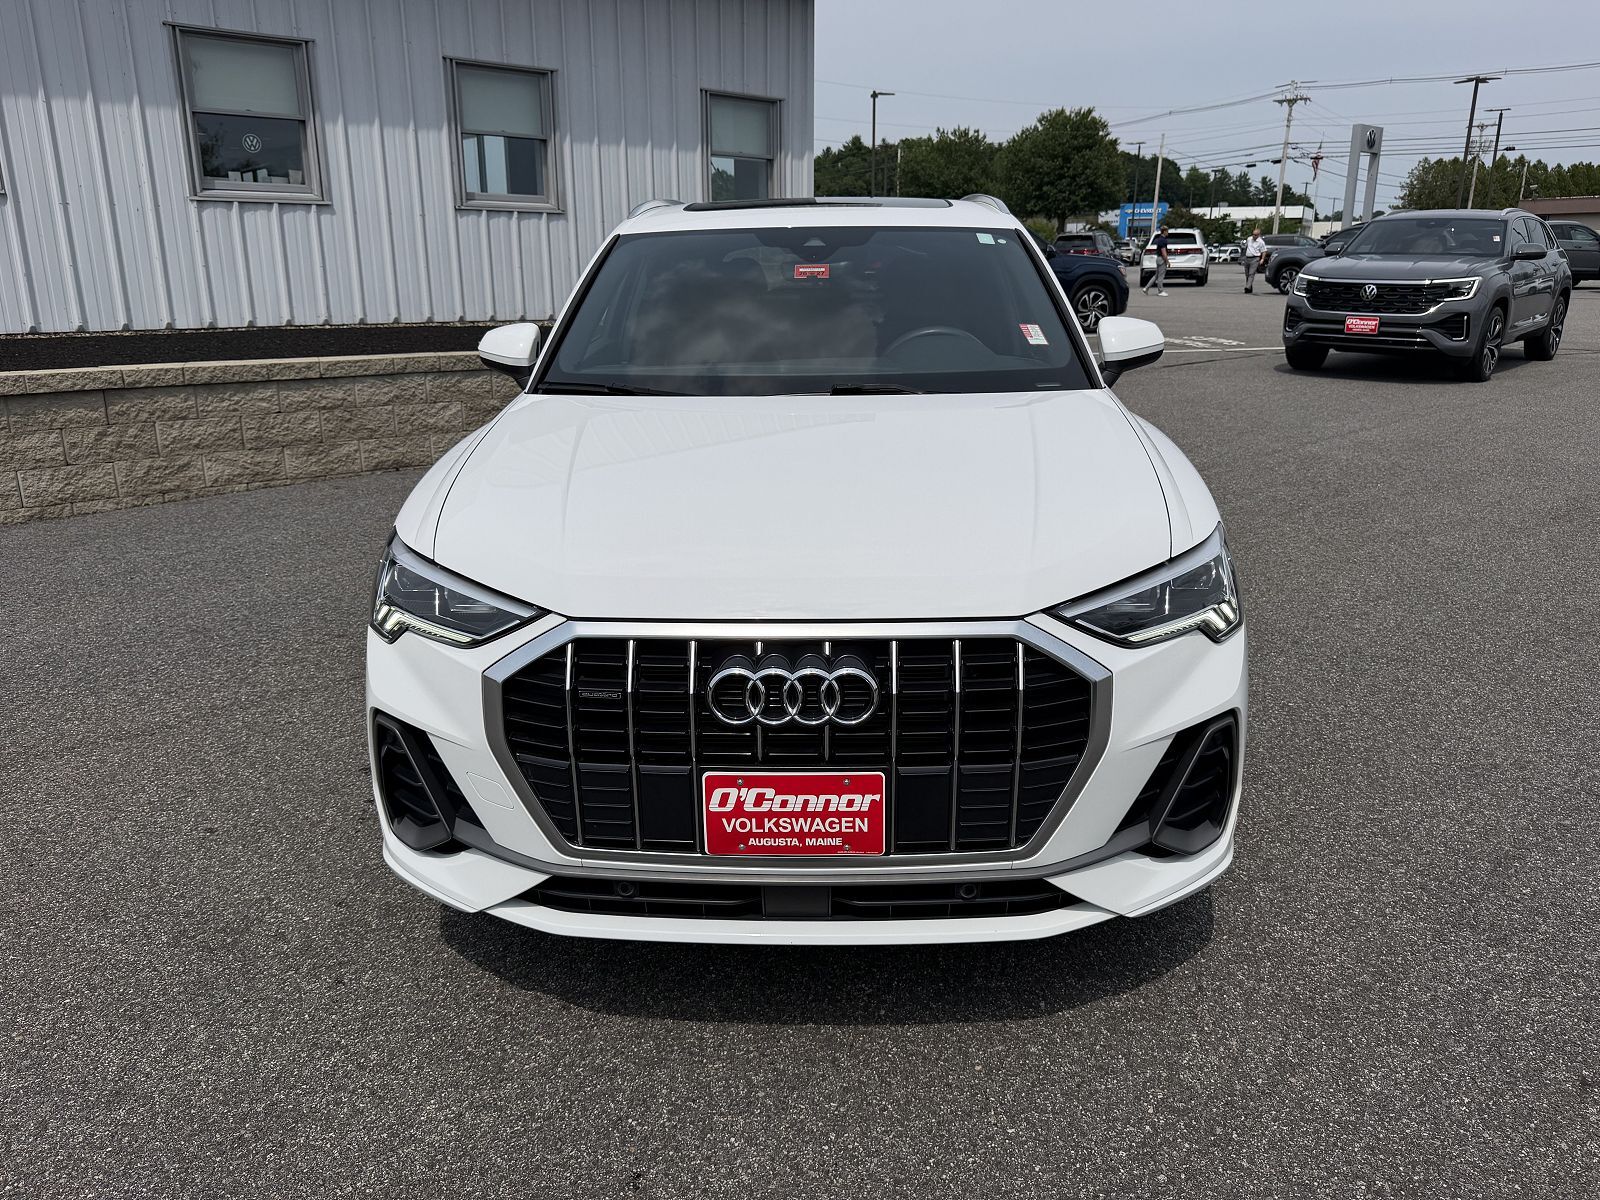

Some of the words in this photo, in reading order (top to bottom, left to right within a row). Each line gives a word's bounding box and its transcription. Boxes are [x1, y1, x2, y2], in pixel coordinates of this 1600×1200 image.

[708, 787, 881, 812] O'Connor
[721, 817, 869, 833] VOLKSWAGEN
[748, 837, 803, 847] AUGUSTA,
[805, 837, 843, 846] MAINE
